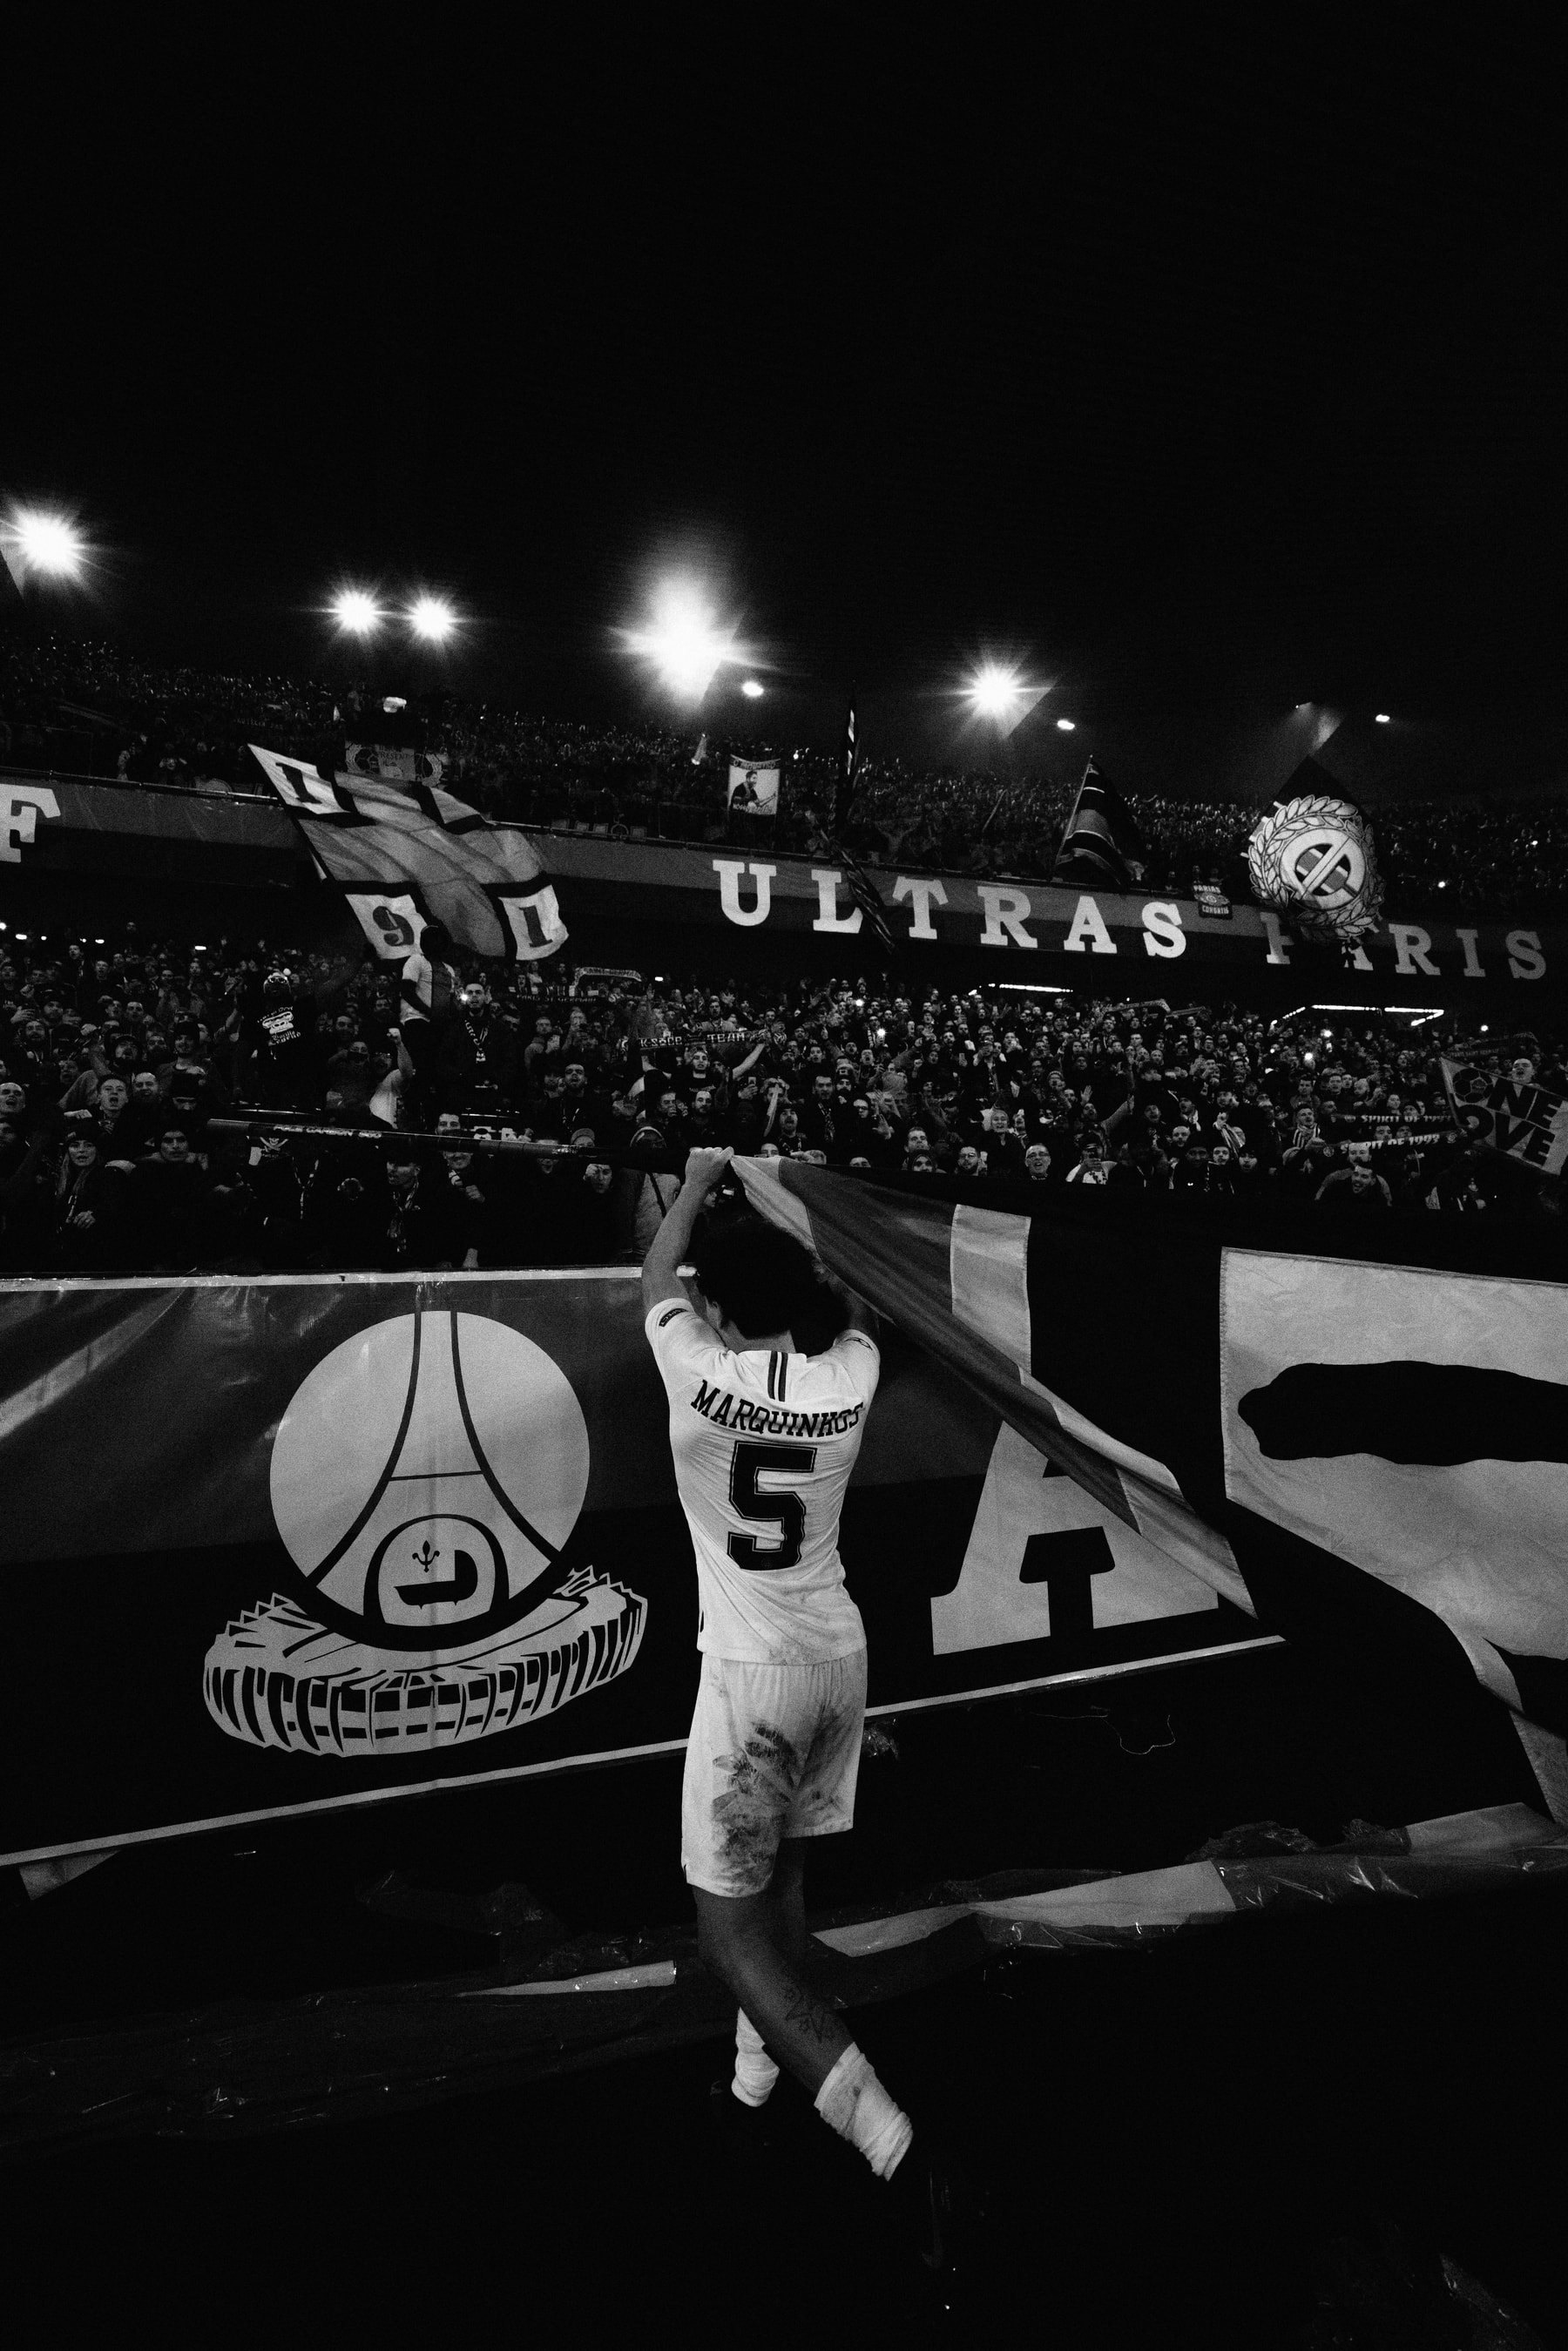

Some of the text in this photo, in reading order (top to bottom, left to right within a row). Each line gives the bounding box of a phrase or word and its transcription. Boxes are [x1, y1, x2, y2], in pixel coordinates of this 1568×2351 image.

[713, 859, 1187, 959] ULTRAS
[706, 1032, 745, 1044] TEAM
[689, 1379, 865, 1438] MARQUINHOS
[727, 1440, 818, 1571] 5
